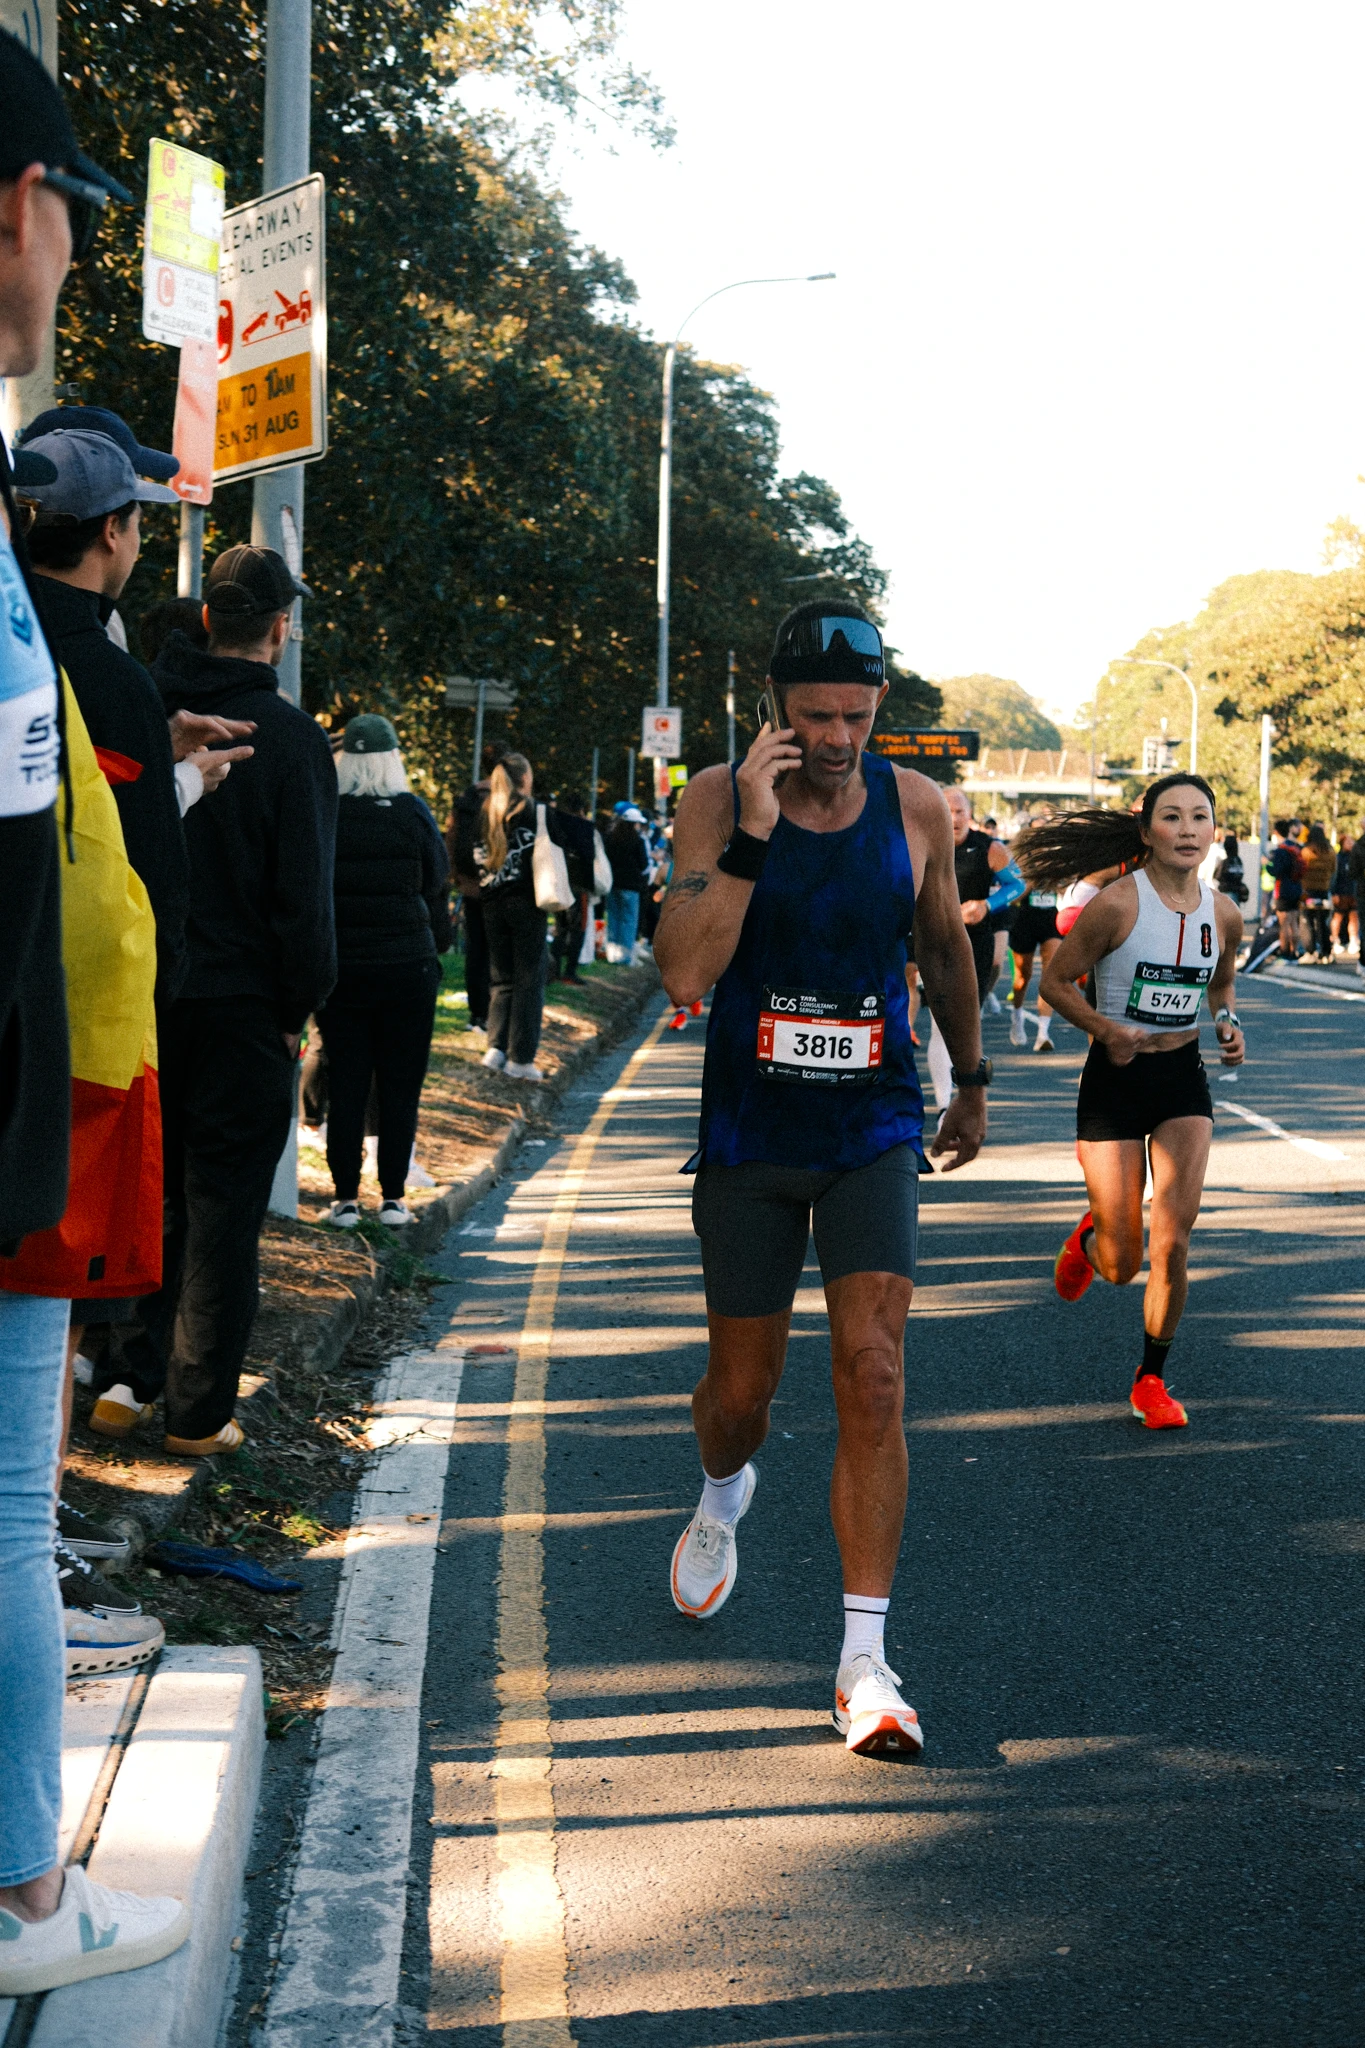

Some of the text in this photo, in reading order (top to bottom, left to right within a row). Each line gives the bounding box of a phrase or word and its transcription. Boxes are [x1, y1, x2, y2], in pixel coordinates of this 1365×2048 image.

[223, 199, 304, 252] LEARWAY
[262, 230, 314, 269] EVENTS
[241, 383, 257, 410] TO
[243, 422, 259, 443] 31
[265, 410, 299, 438] AUG
[1142, 966, 1160, 979] tcs
[770, 992, 817, 1012] tcs TATA
[799, 1001, 838, 1011] CONSULTANCY
[1150, 992, 1192, 1010] 5747
[798, 1007, 824, 1016] SERVICES
[859, 1009, 878, 1018] TATA
[762, 1035, 769, 1047] 1
[792, 1032, 854, 1060] 3816
